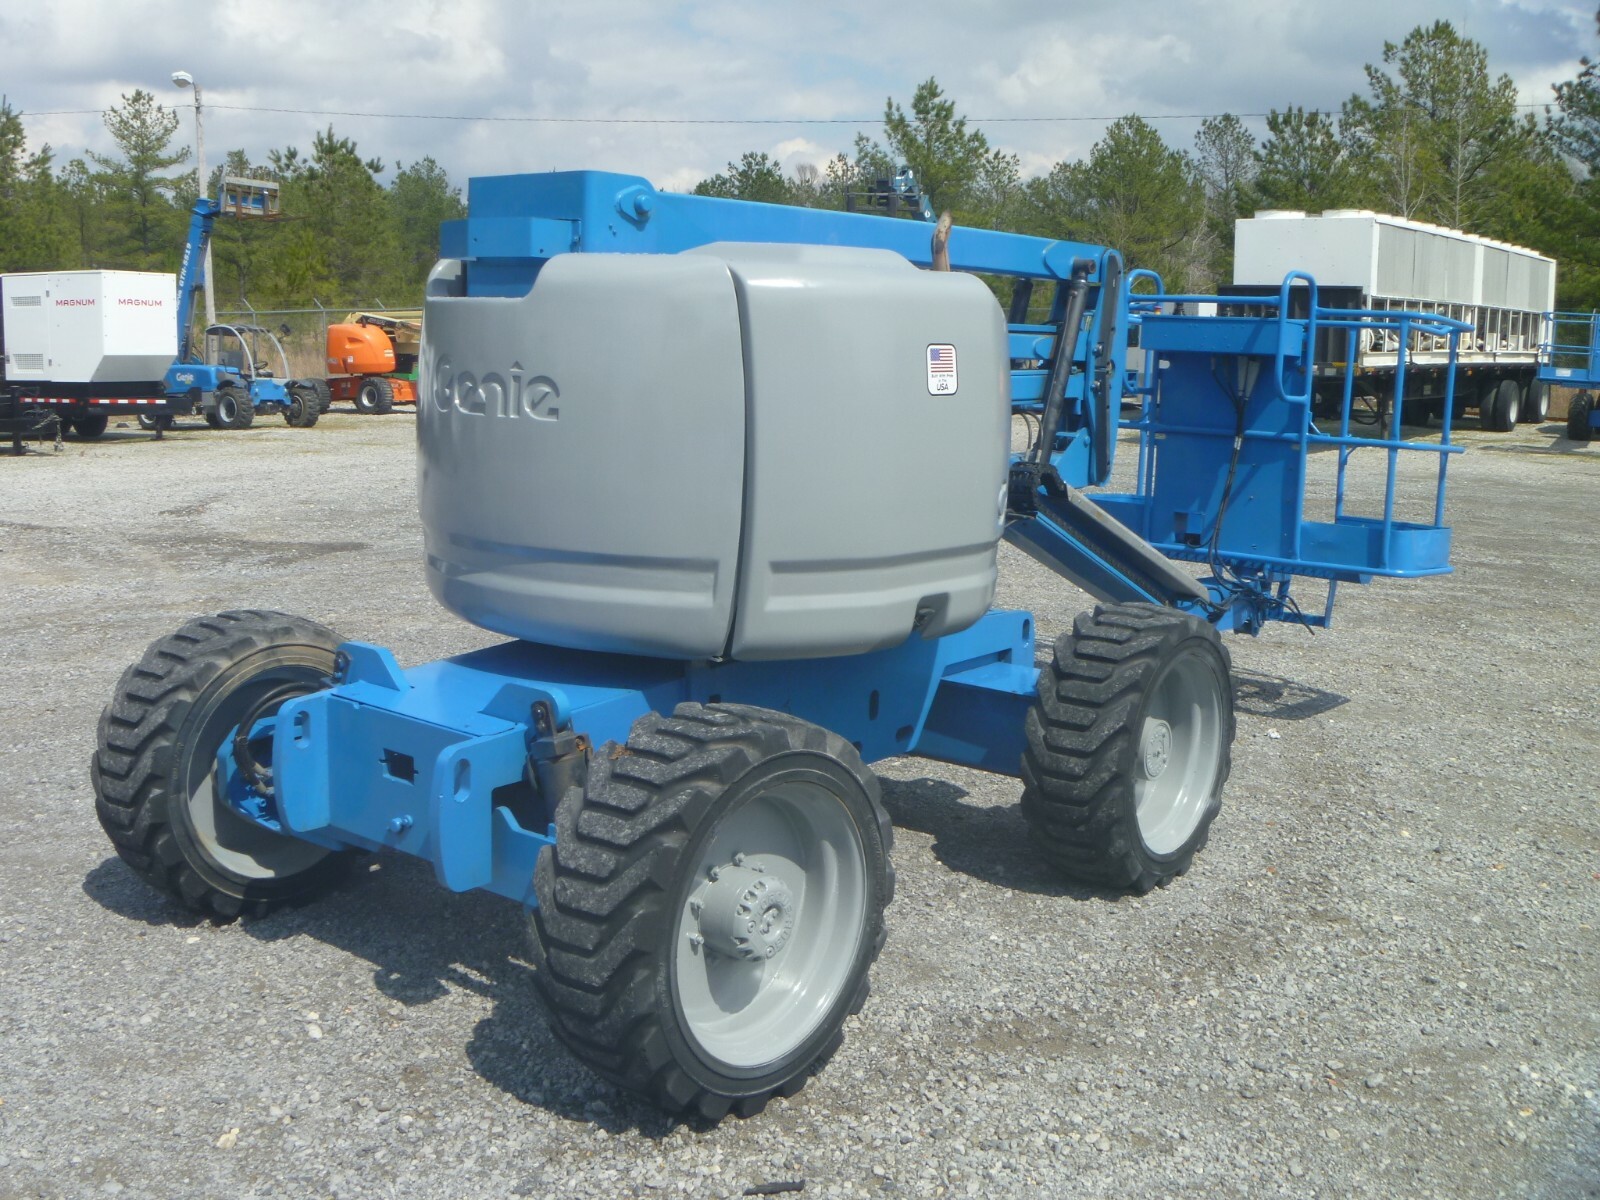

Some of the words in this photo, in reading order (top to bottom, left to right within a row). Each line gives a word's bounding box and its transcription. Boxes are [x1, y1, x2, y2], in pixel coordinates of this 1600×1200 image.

[55, 298, 95, 307] MAGNUM
[118, 298, 162, 307] MAGNUM
[176, 372, 194, 382] Genie
[433, 353, 561, 422] Genie
[937, 383, 949, 391] USA
